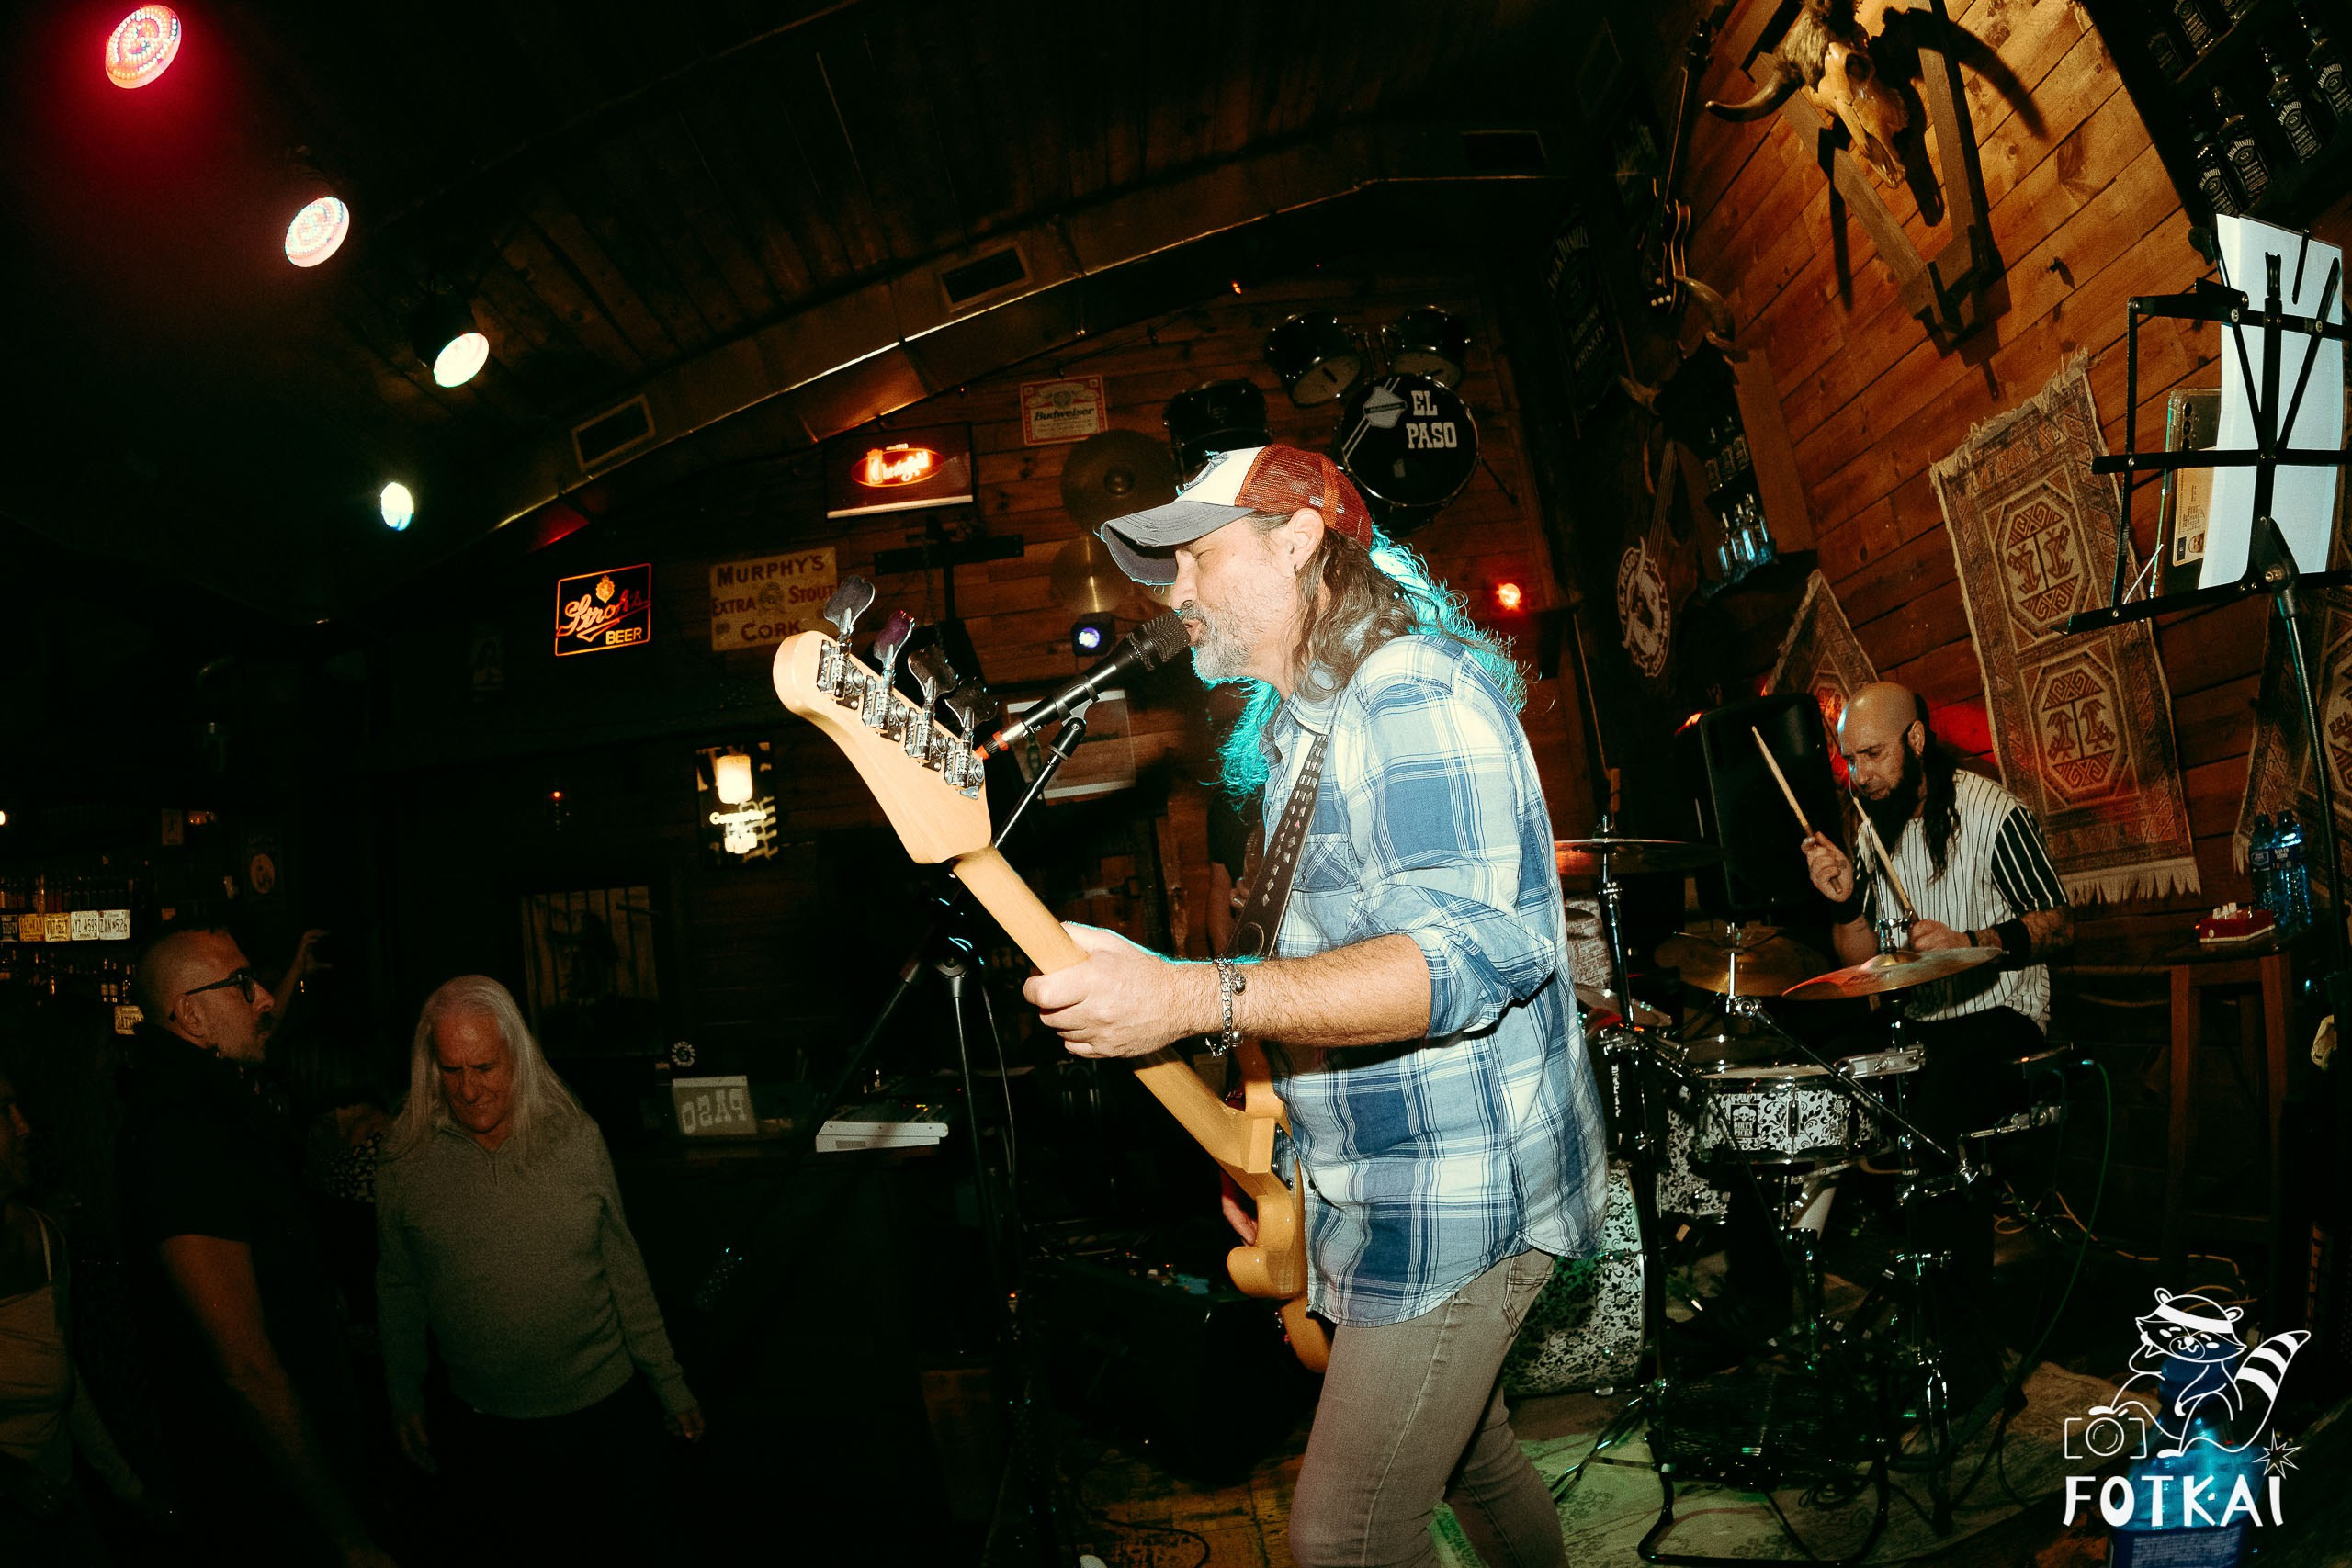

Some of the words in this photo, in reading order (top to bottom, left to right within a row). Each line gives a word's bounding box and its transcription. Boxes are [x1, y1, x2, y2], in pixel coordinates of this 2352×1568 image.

[1035, 407, 1095, 421] Budweiser
[1411, 389, 1439, 417] EL
[1406, 422, 1458, 450] PASO
[717, 555, 825, 588] MURPHY'S
[558, 589, 650, 639] Stroh's
[712, 597, 757, 616] EXTRA
[788, 585, 837, 604] STOUT
[605, 626, 643, 646] BEER
[1733, 1122, 1754, 1130] DIRTY
[1734, 1129, 1754, 1137] PICKS
